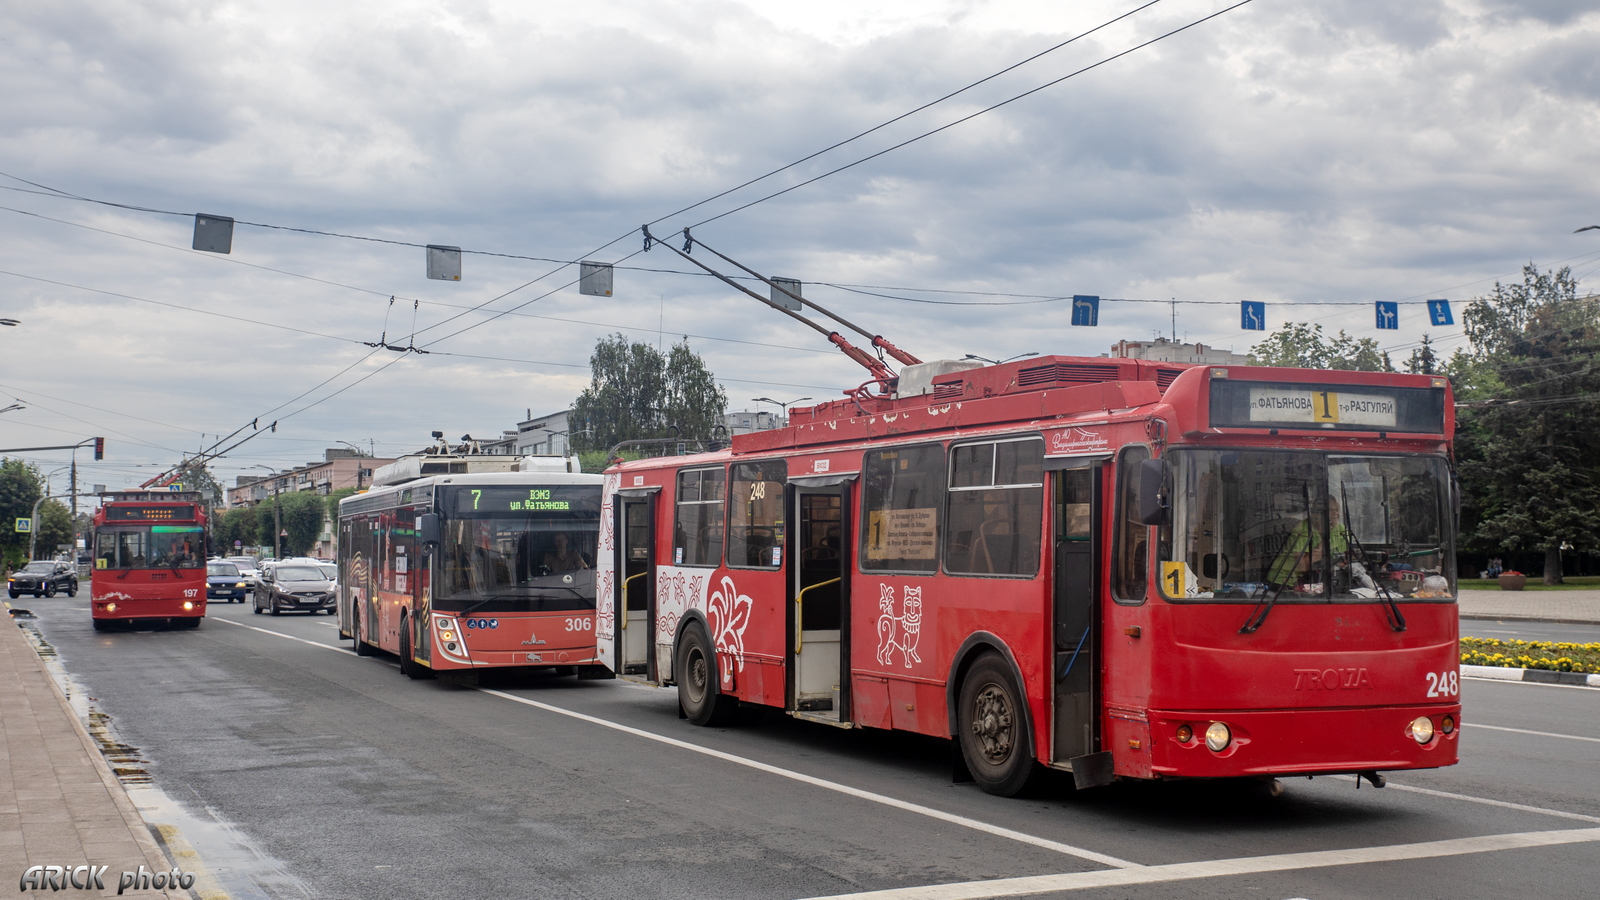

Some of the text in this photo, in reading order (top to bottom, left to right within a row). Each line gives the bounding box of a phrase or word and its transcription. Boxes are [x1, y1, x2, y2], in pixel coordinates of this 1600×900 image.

[1258, 397, 1313, 409] ФАТЬЯНОВА
[1320, 391, 1333, 419] 1
[1350, 400, 1393, 414] РАЗГУЛЯЙ
[471, 489, 482, 510] 7
[529, 489, 551, 500] ВЭМЗ
[750, 481, 765, 500] 248
[874, 519, 882, 550] 1
[1167, 569, 1179, 595] 1
[183, 589, 199, 597] 197
[564, 617, 592, 632] 306
[1426, 670, 1458, 698] 248
